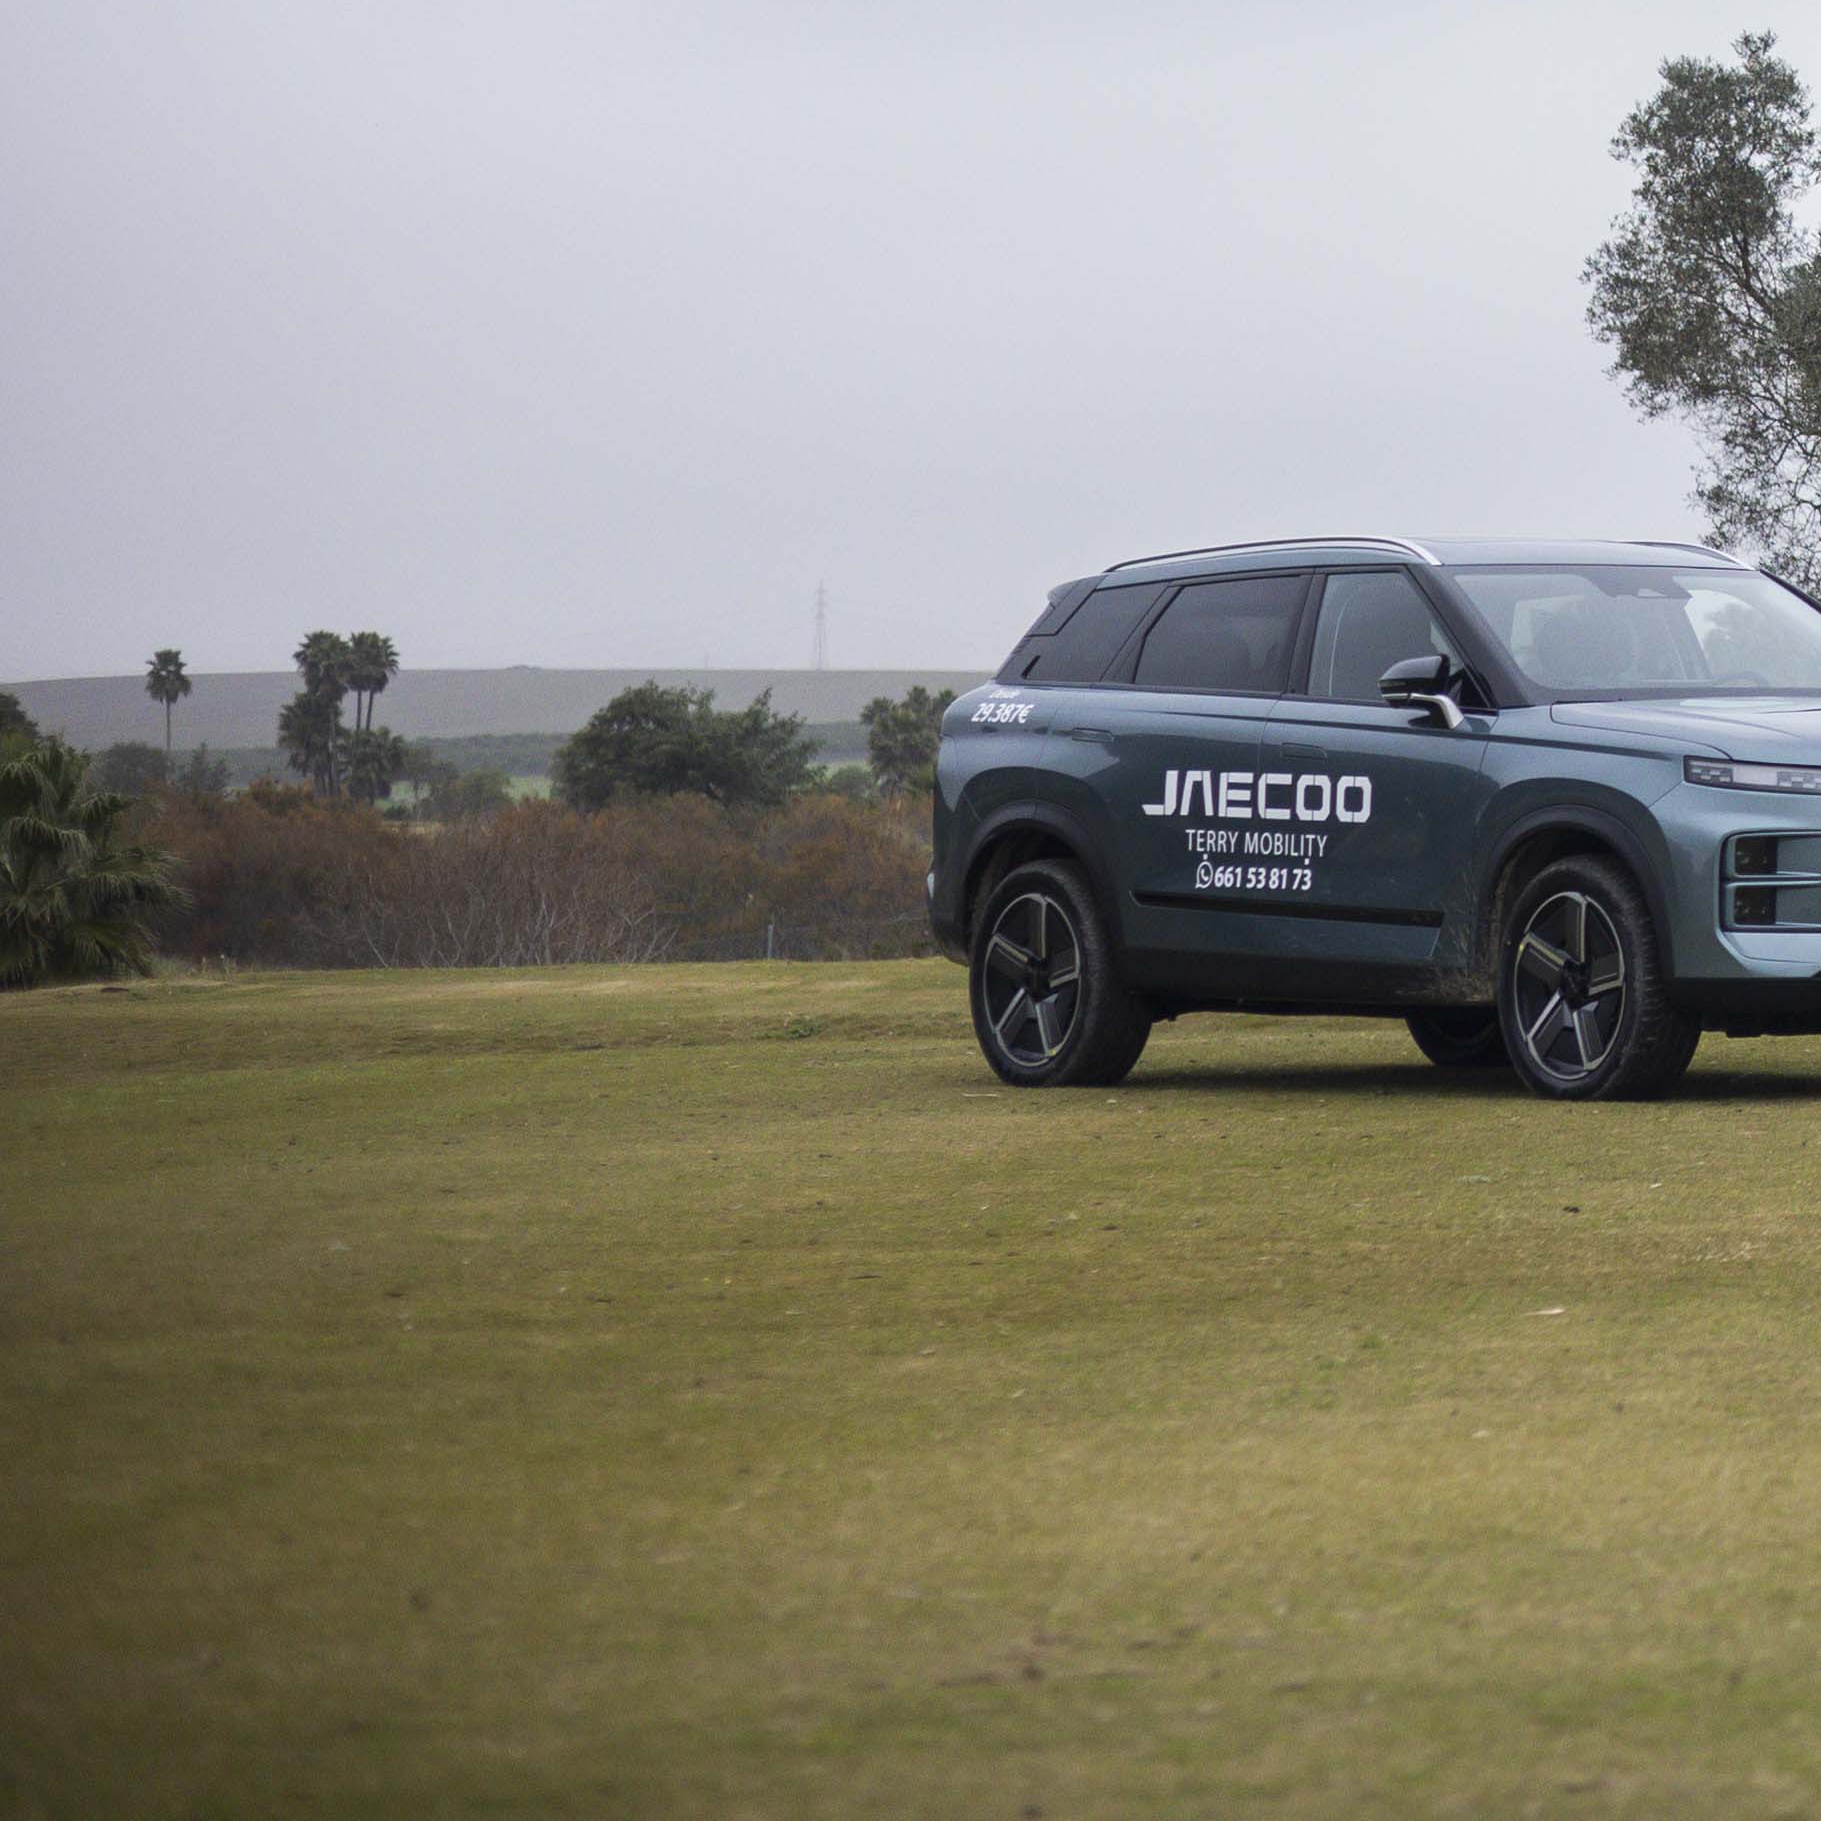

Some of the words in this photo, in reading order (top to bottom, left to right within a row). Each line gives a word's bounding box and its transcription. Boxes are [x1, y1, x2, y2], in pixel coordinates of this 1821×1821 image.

[971, 702, 1035, 724] 29.387€
[1141, 770, 1373, 823] JAECOO
[1185, 829, 1239, 853] TERRY
[1244, 832, 1328, 857] MOBILITY
[1214, 866, 1241, 888] 661
[1246, 867, 1266, 888] 53
[1269, 868, 1287, 889] 81
[1292, 869, 1312, 891] 73
